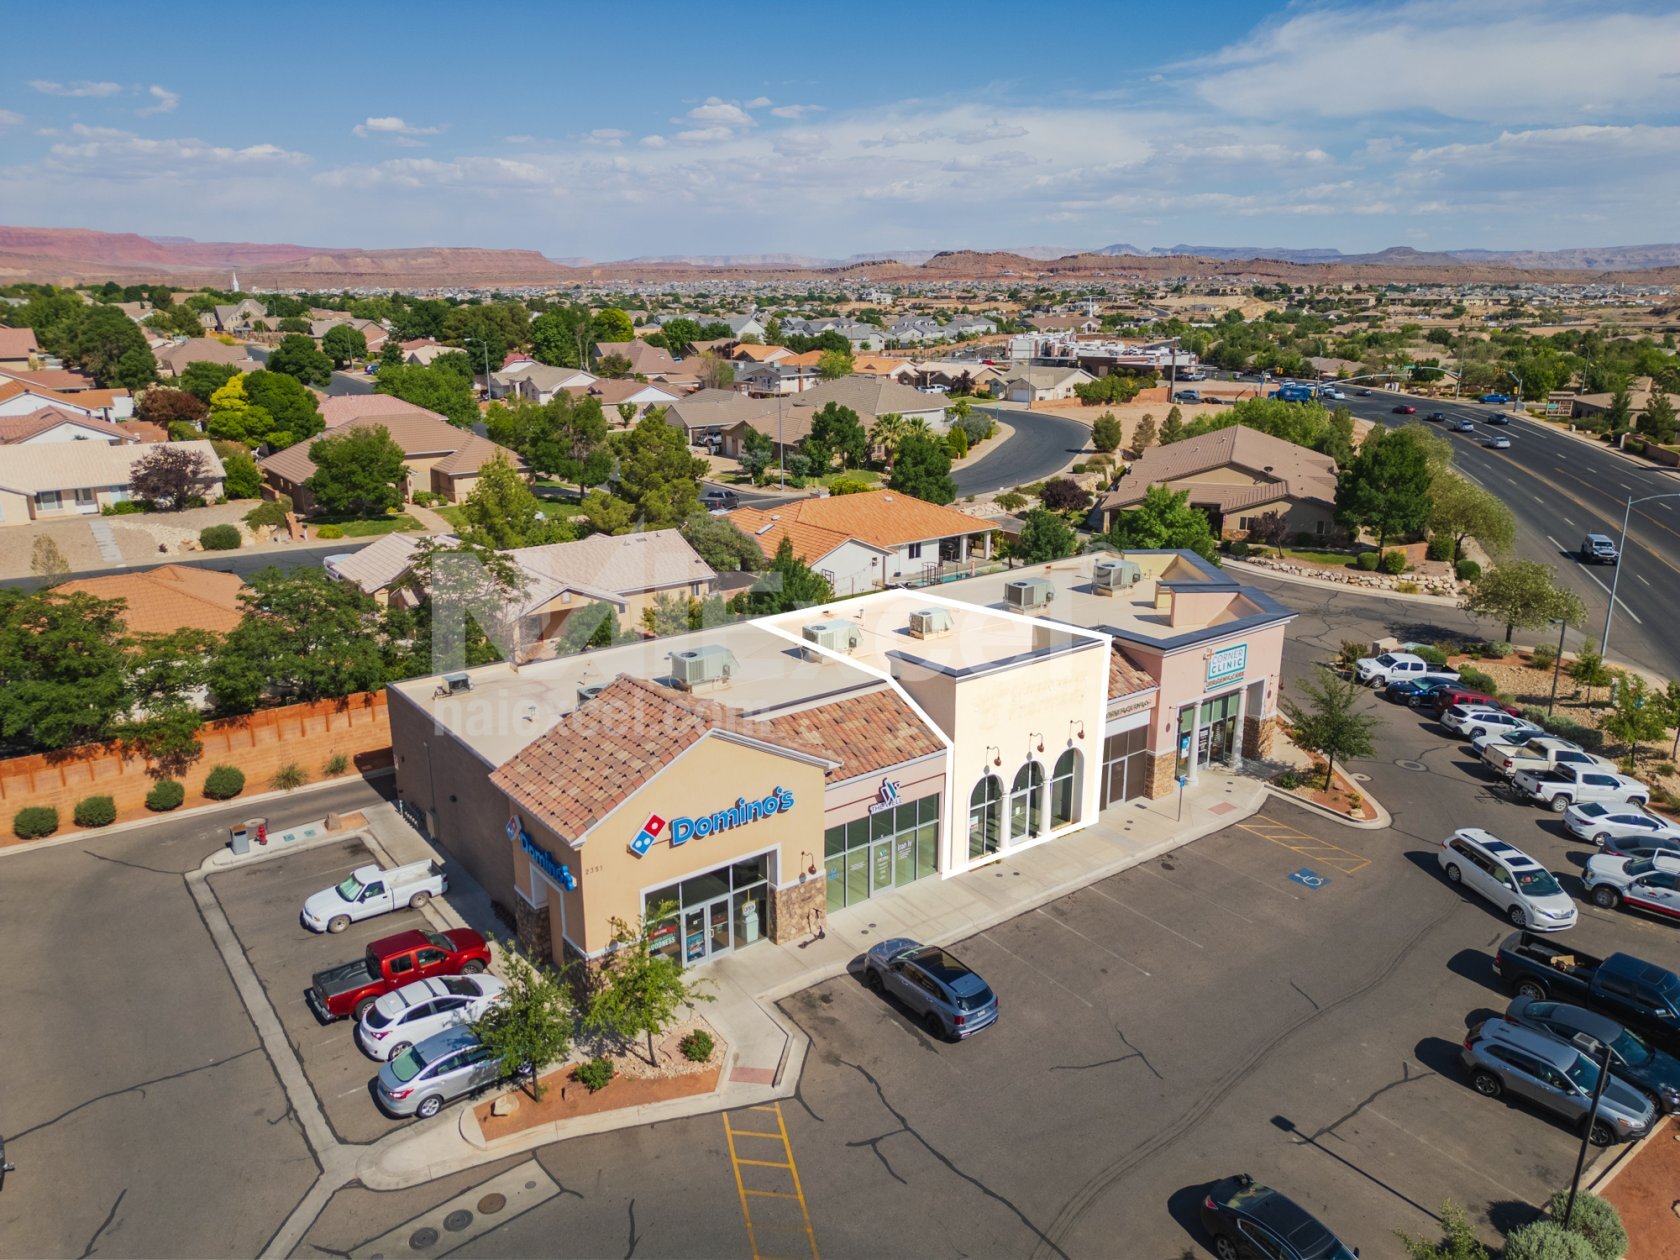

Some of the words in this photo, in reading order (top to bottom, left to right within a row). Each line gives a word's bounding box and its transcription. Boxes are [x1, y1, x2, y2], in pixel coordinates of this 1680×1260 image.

[1212, 649, 1244, 665] CORNER
[1211, 658, 1242, 674] CLINIC
[671, 785, 796, 846] Domino's
